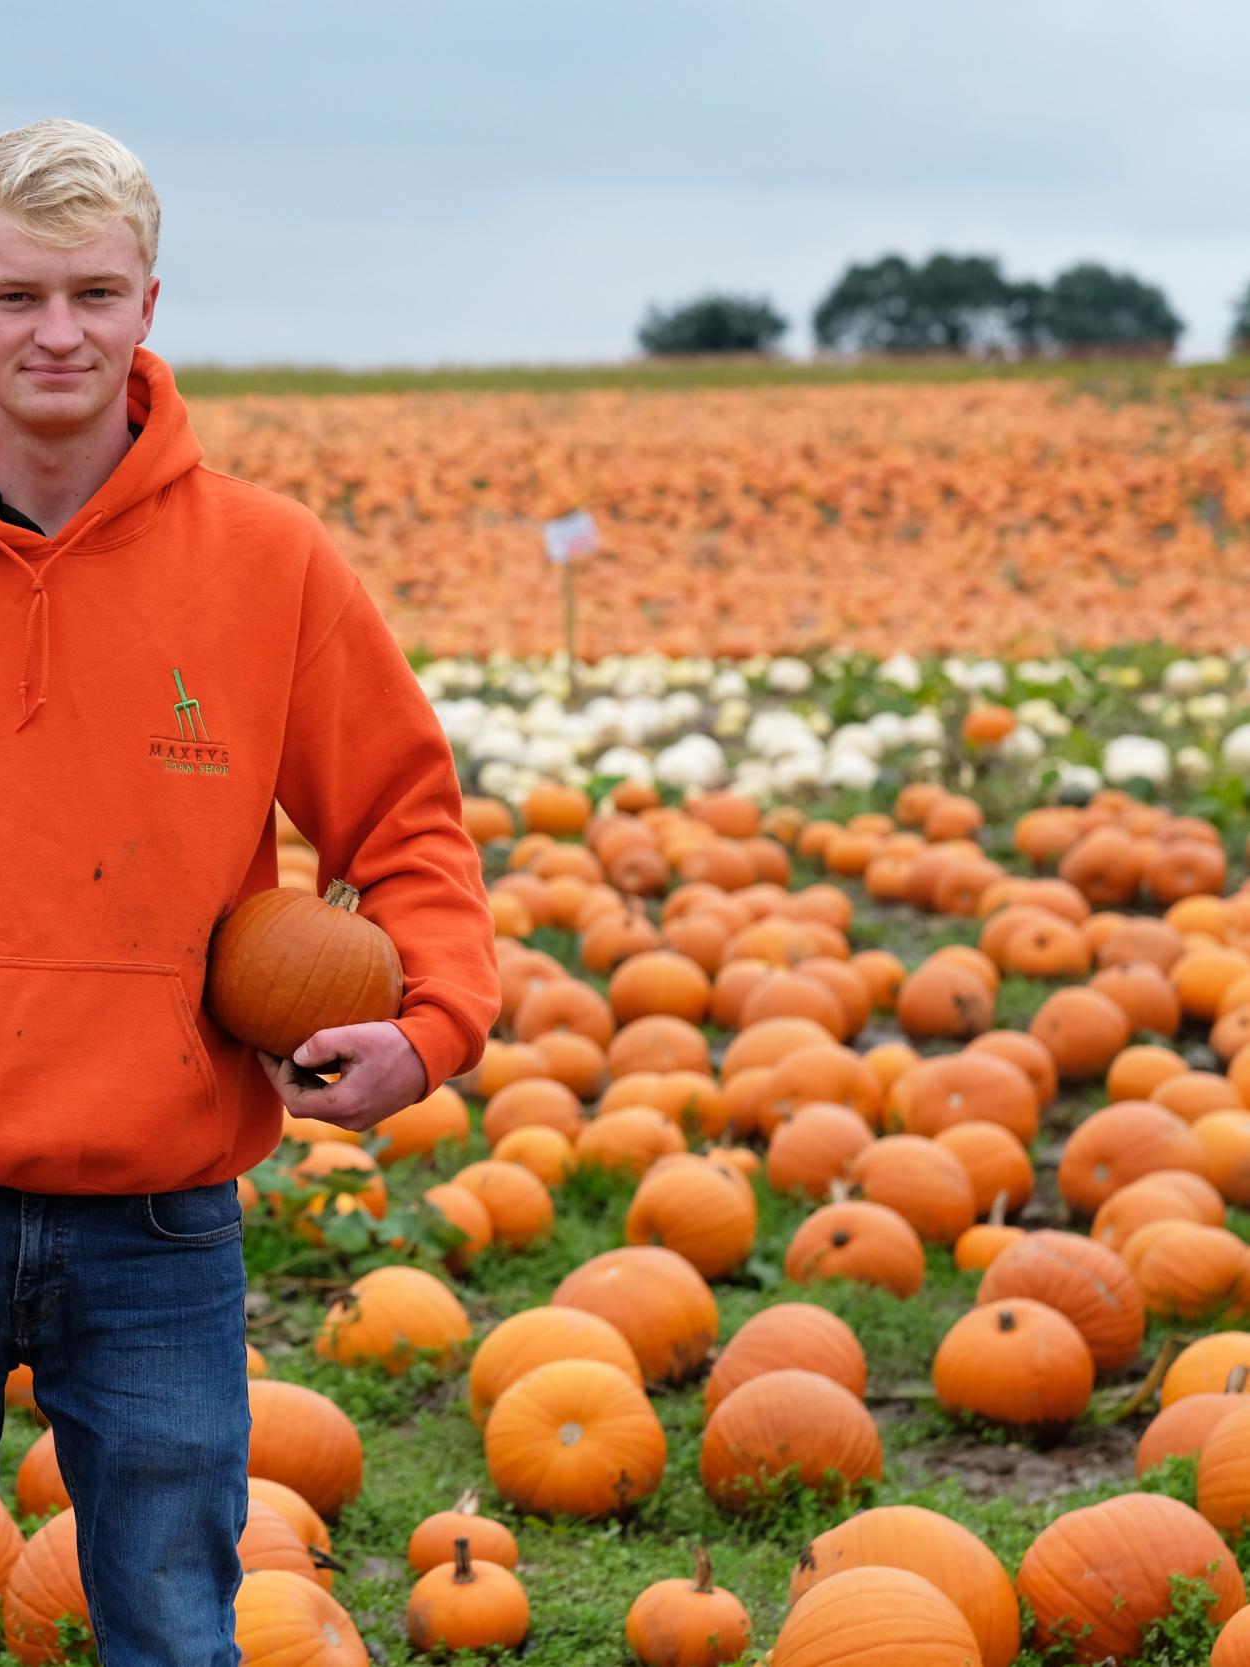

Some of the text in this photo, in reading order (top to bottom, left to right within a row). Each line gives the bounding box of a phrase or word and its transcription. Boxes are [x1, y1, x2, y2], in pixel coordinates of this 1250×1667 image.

[149, 743, 229, 763] MAXEYS
[165, 760, 229, 776] FARM SHOP
